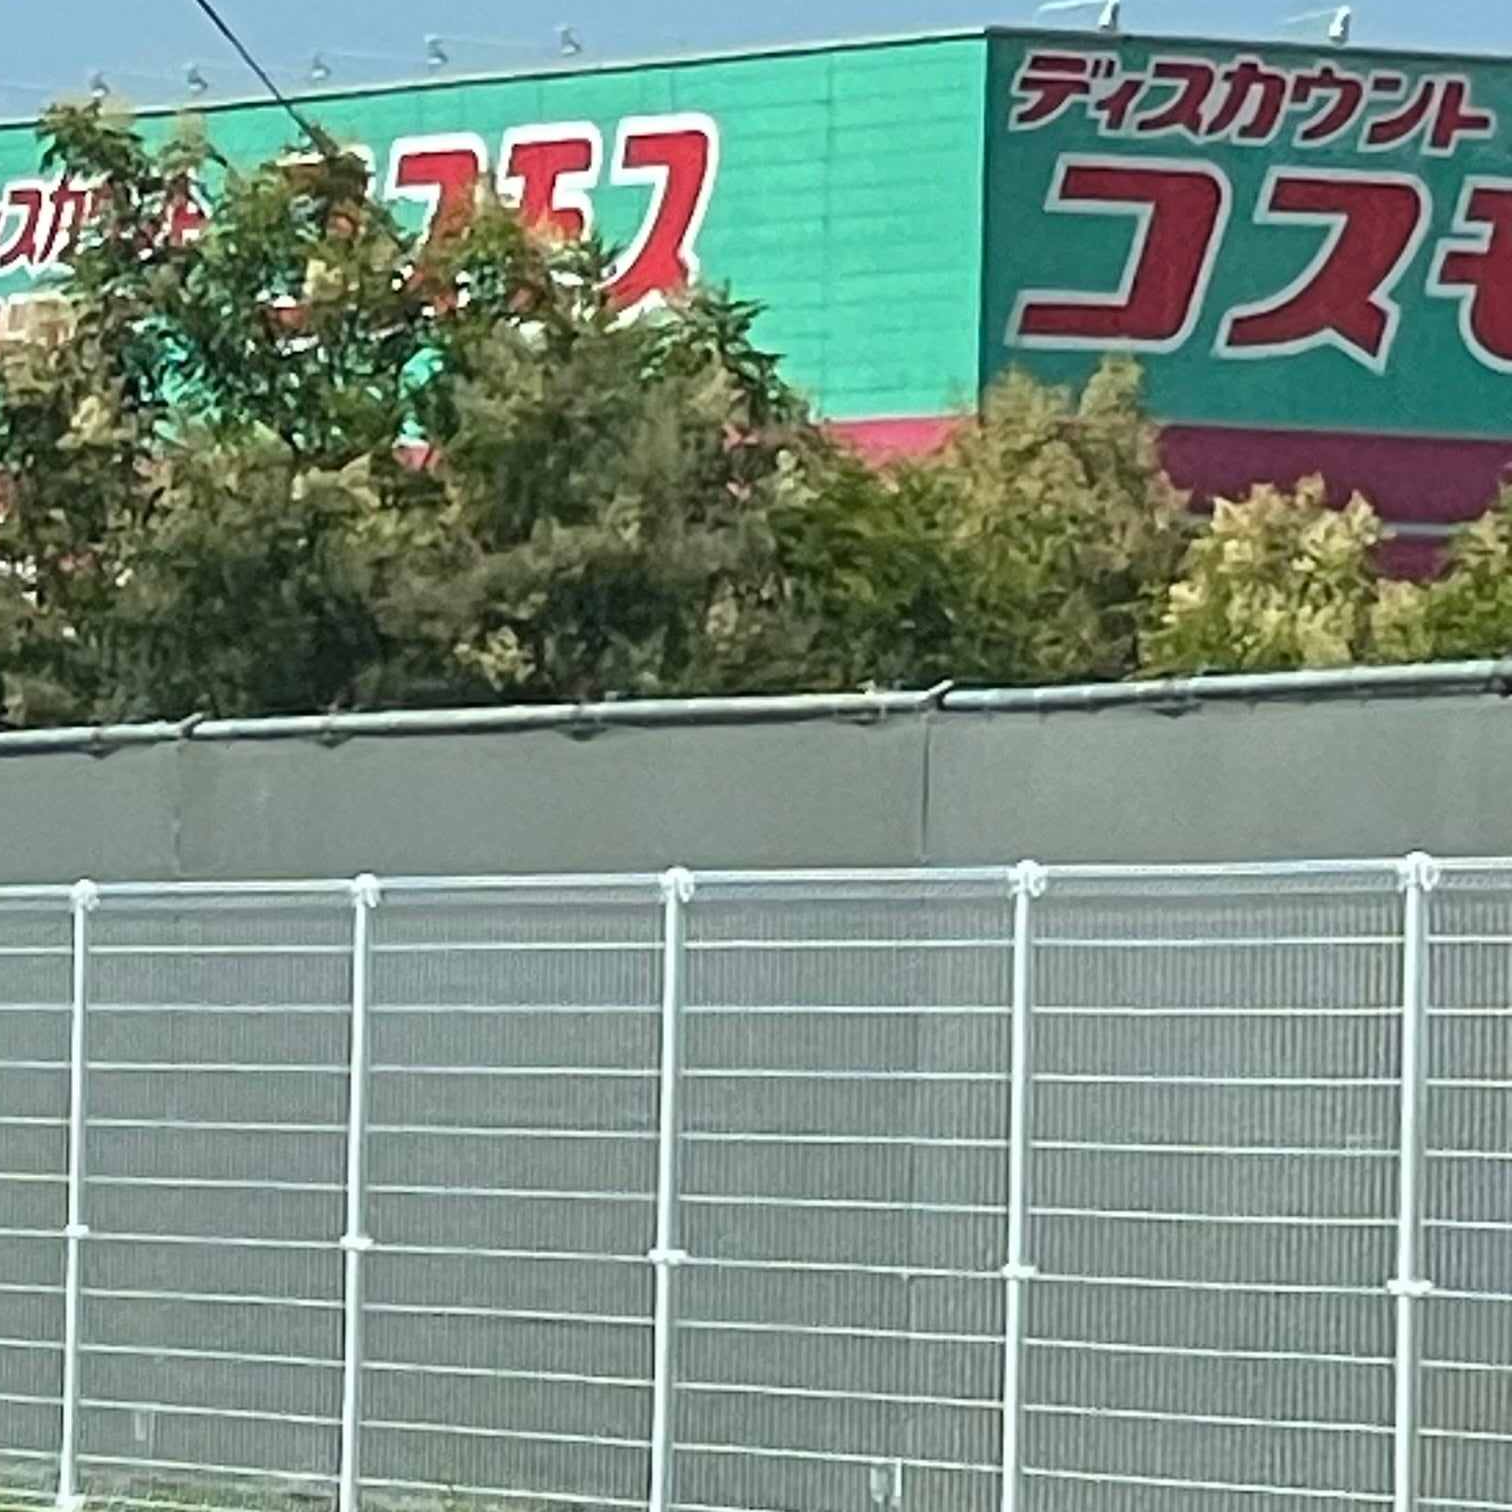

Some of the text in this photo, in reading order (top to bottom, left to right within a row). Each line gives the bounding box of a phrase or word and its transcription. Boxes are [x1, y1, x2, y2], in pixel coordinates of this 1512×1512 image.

[1009, 51, 1495, 156] ディスカウント
